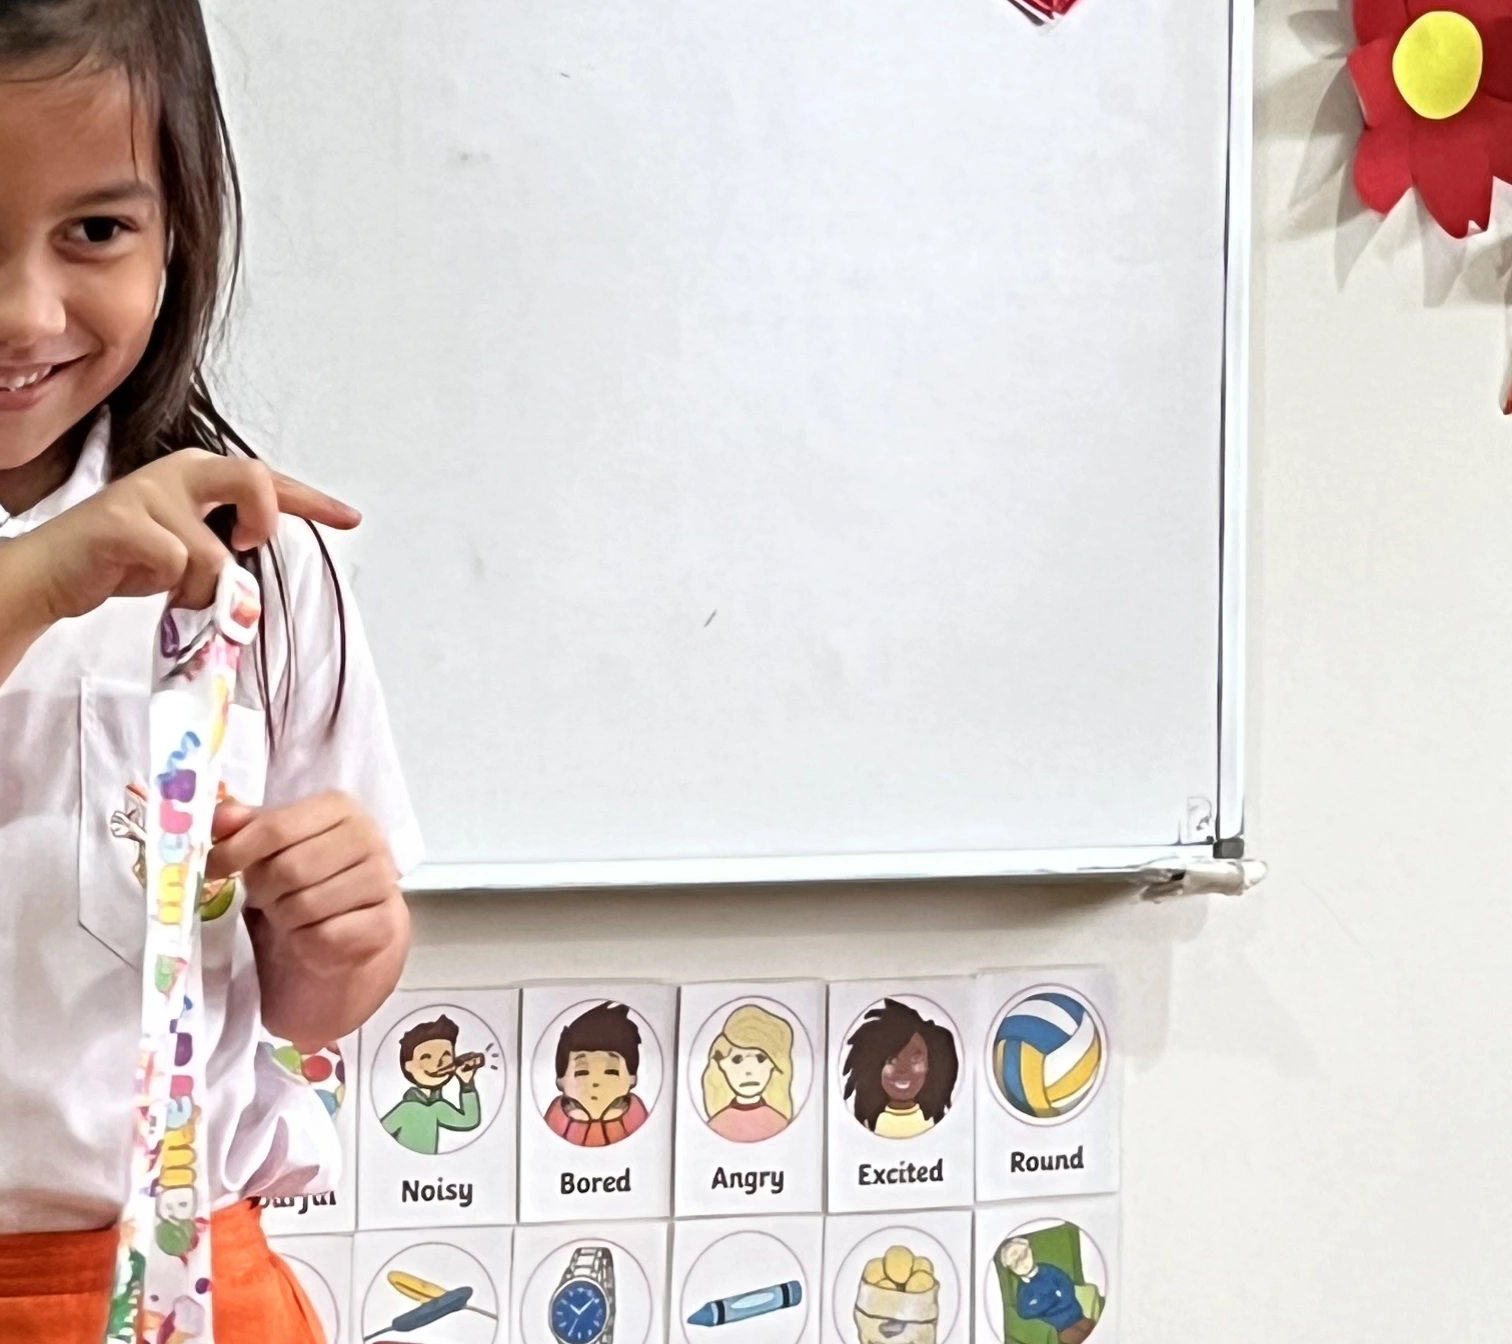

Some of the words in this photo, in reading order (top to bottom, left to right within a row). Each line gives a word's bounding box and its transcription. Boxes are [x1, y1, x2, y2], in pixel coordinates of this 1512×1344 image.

[858, 1159, 944, 1186] Excited
[1010, 1146, 1084, 1173] Round
[401, 1177, 473, 1207] Noisy
[560, 1168, 631, 1195] Bored
[711, 1166, 785, 1194] Angry
